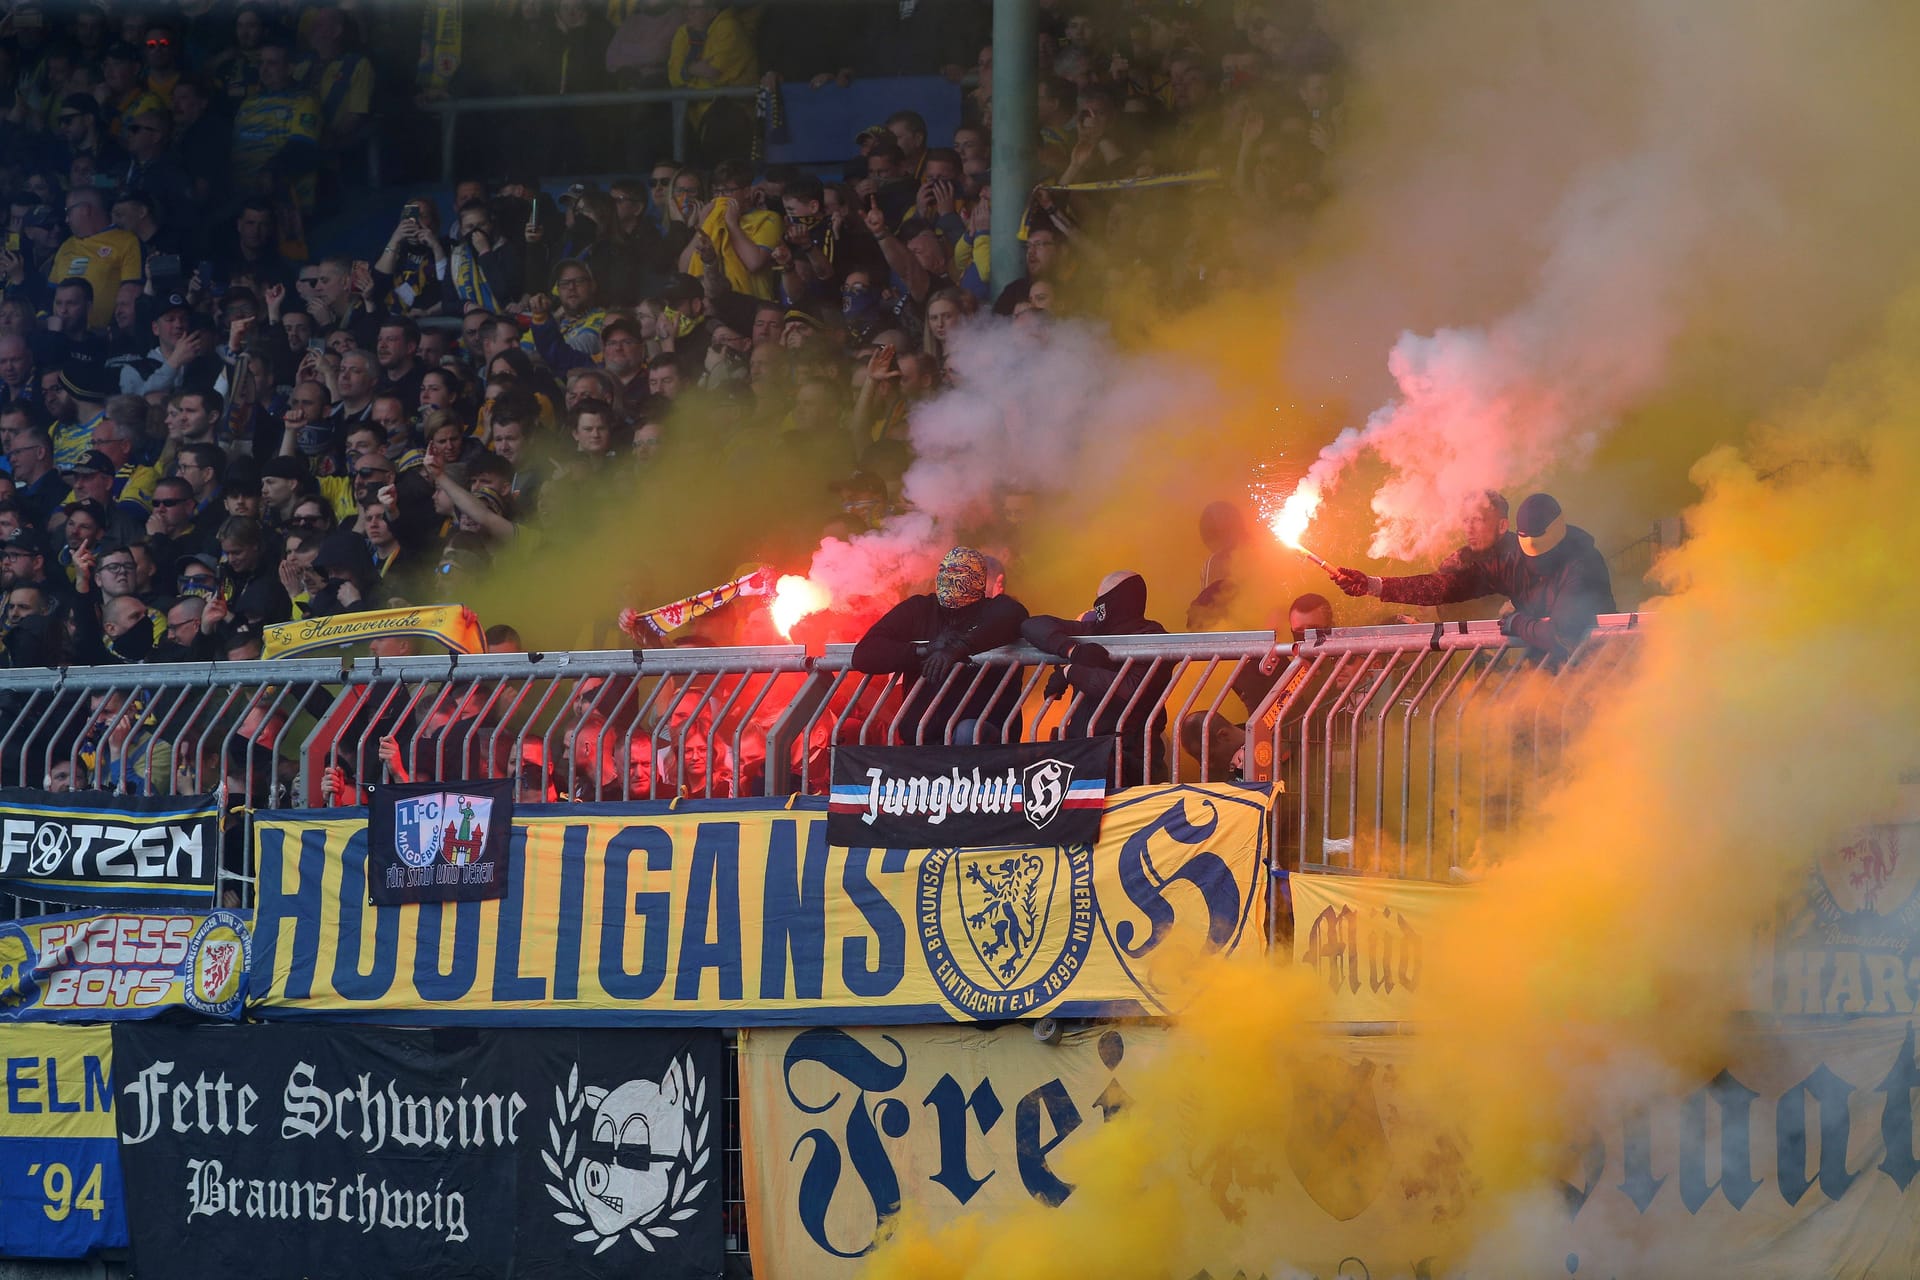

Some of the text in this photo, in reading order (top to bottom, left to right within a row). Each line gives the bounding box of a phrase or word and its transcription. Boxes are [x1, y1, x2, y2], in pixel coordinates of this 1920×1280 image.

[860, 766, 1017, 827] Jungblut
[398, 824, 440, 865] MAGDEBURG
[250, 820, 910, 1002] HOOLIGANS
[44, 968, 176, 1008] BOYS
[935, 953, 1079, 1014] EINTRACHT E.V. 1895
[122, 1058, 528, 1155] Fette Schweine
[185, 1158, 470, 1244] Braunschweig
